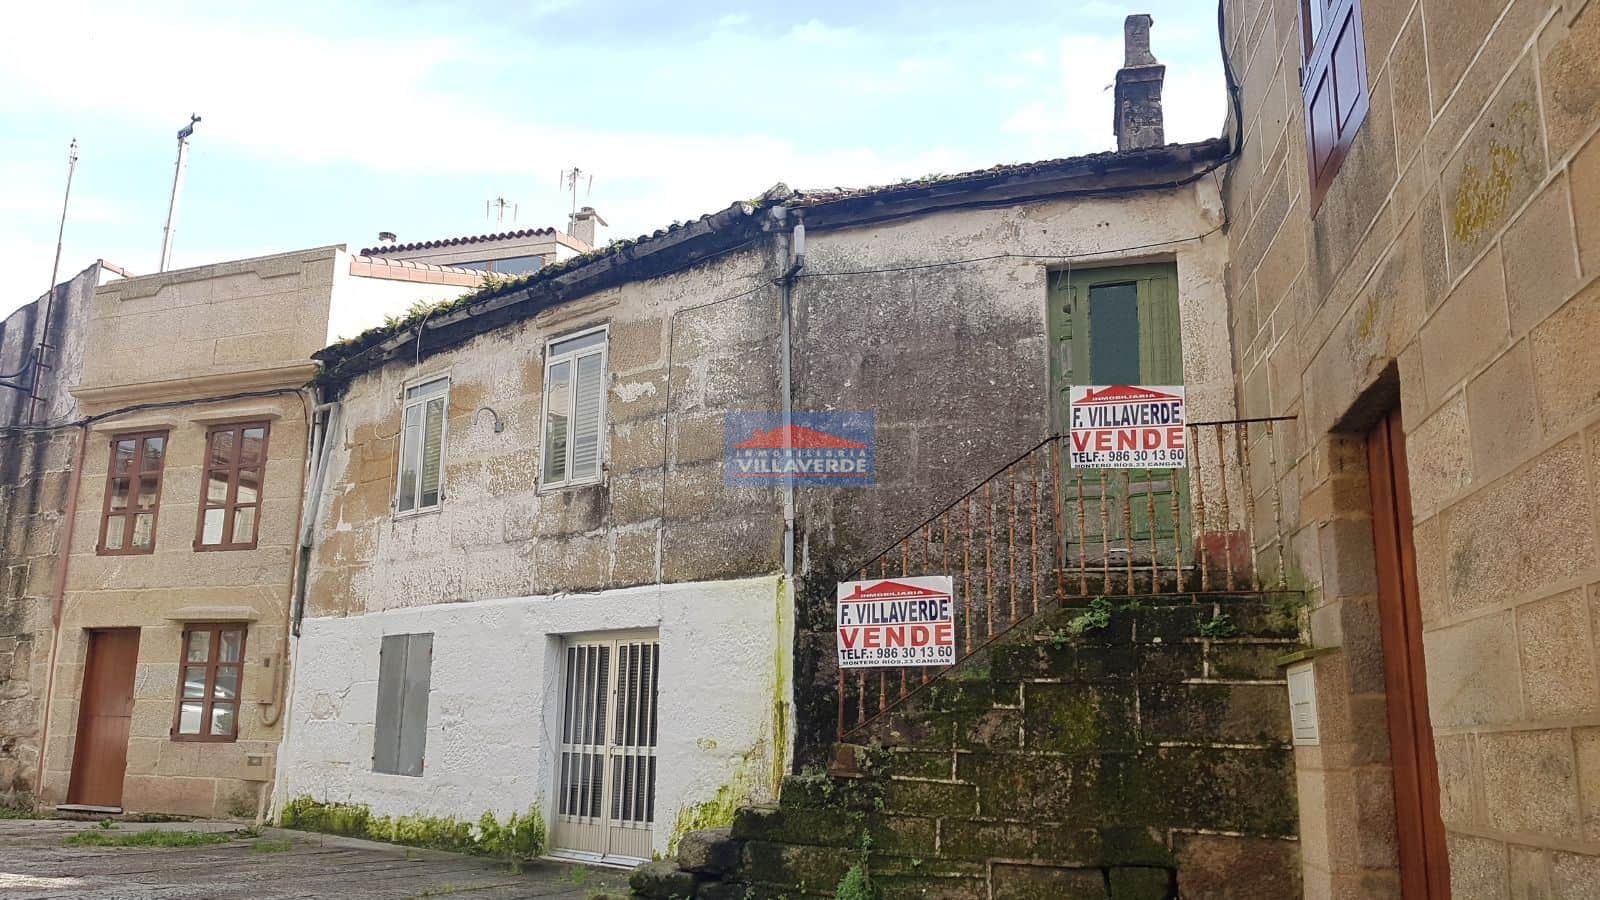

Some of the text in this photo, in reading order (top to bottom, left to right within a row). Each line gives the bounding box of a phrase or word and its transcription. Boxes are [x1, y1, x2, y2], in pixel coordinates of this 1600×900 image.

[1073, 402, 1180, 428] F. VILLAVERDE
[1071, 427, 1185, 452] VENDE
[1072, 449, 1184, 463] TELF.: 986 30 13 60
[841, 599, 948, 625] F. VILLAVERDE
[840, 624, 953, 649] VENDE
[841, 646, 953, 660] TELF.: 986 30 13 60
